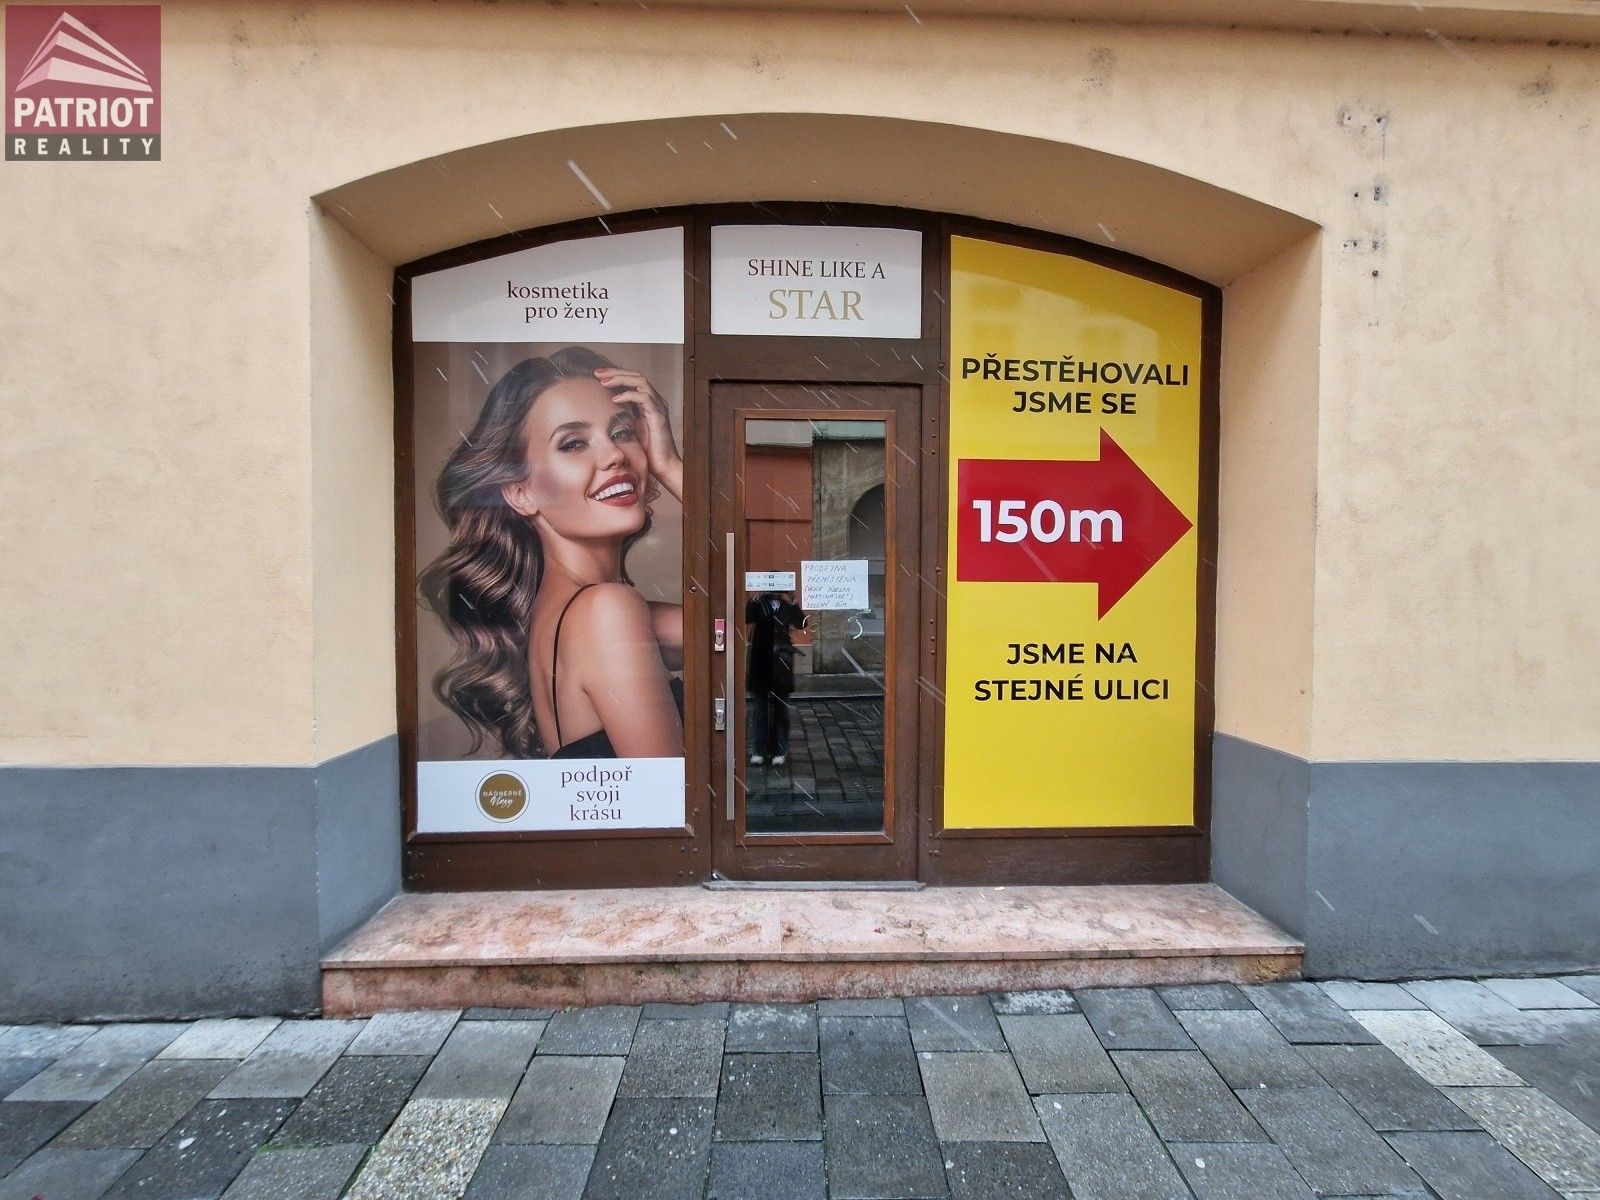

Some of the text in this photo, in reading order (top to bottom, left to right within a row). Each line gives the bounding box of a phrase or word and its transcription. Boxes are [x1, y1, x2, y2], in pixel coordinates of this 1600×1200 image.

[748, 258, 887, 280] SHINE LIKE A
[506, 280, 609, 300] kosmetika
[525, 301, 609, 325] pro ženy
[768, 287, 865, 321] STAR
[962, 352, 1189, 386] PŘESTĚHOVALI
[1012, 392, 1137, 415] JSME SE
[972, 499, 1123, 543] 150m
[1006, 642, 1138, 665] JSME NA
[974, 673, 1169, 702] STEJNÉ ULICI
[561, 765, 633, 788] podpoř
[576, 785, 621, 806] svoji
[570, 804, 622, 821] krásu
